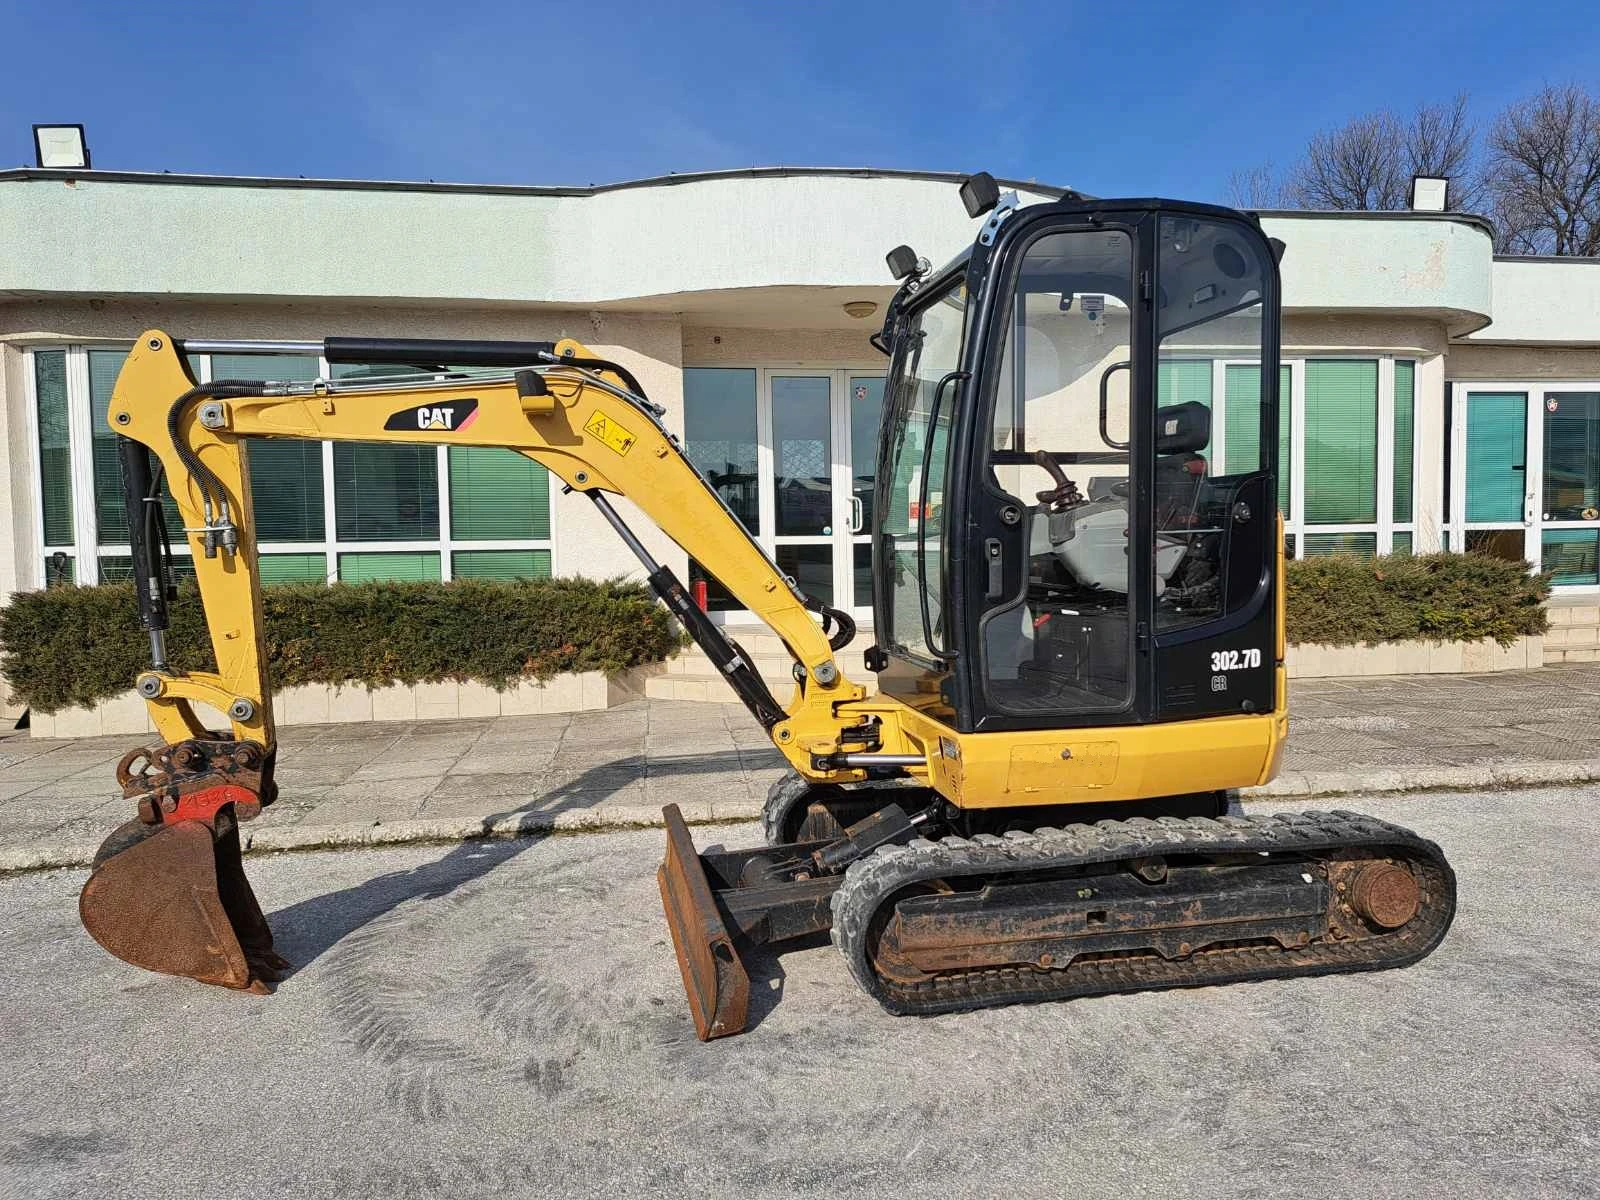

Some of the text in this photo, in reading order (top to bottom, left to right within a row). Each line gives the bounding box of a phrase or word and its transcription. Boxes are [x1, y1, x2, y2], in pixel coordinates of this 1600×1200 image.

[417, 407, 455, 430] CAT
[1211, 648, 1261, 672] 302.7D
[1211, 675, 1228, 692] CR
